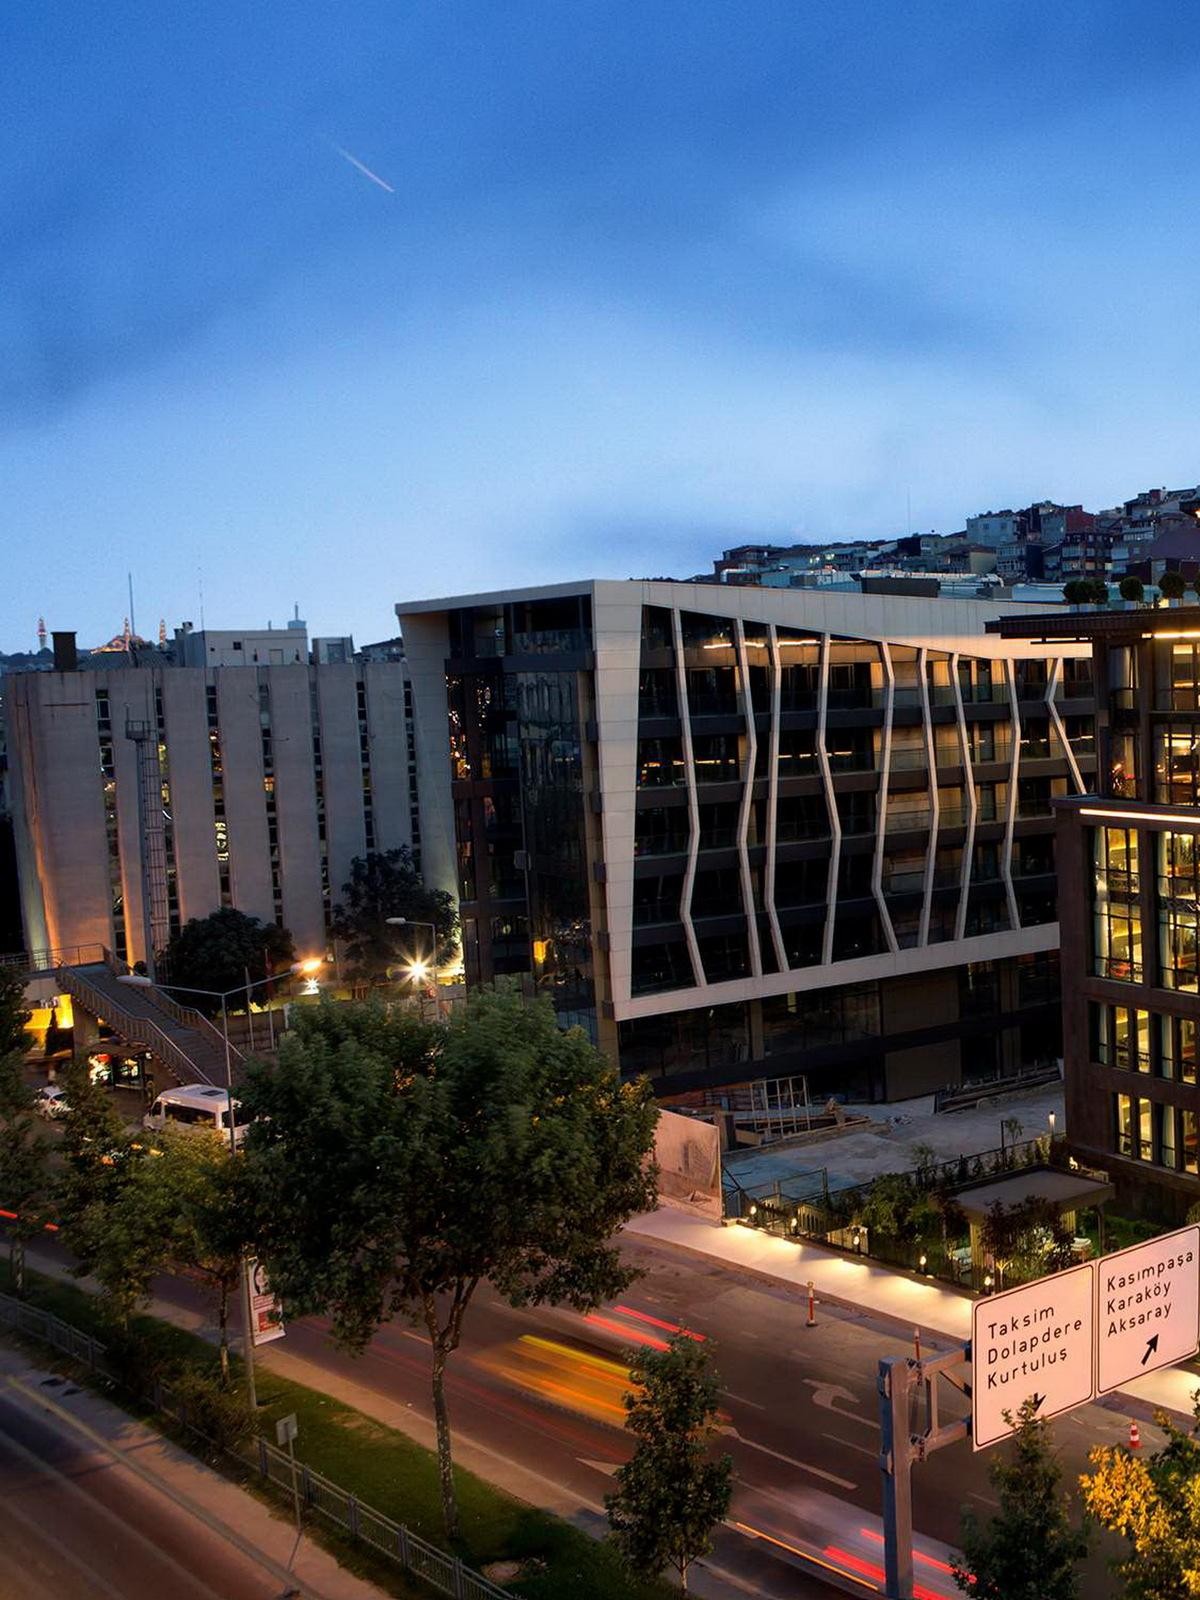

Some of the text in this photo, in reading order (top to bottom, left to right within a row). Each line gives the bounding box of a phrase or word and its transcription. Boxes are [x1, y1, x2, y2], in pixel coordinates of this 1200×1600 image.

[1106, 1250, 1194, 1292] Kasımpaşa
[1106, 1280, 1172, 1315] Karaköy
[987, 1304, 1055, 1340] Taksim
[1107, 1302, 1172, 1337] Aksaray
[987, 1318, 1082, 1365] Dolapdere
[987, 1346, 1068, 1389] Kurtuluş
